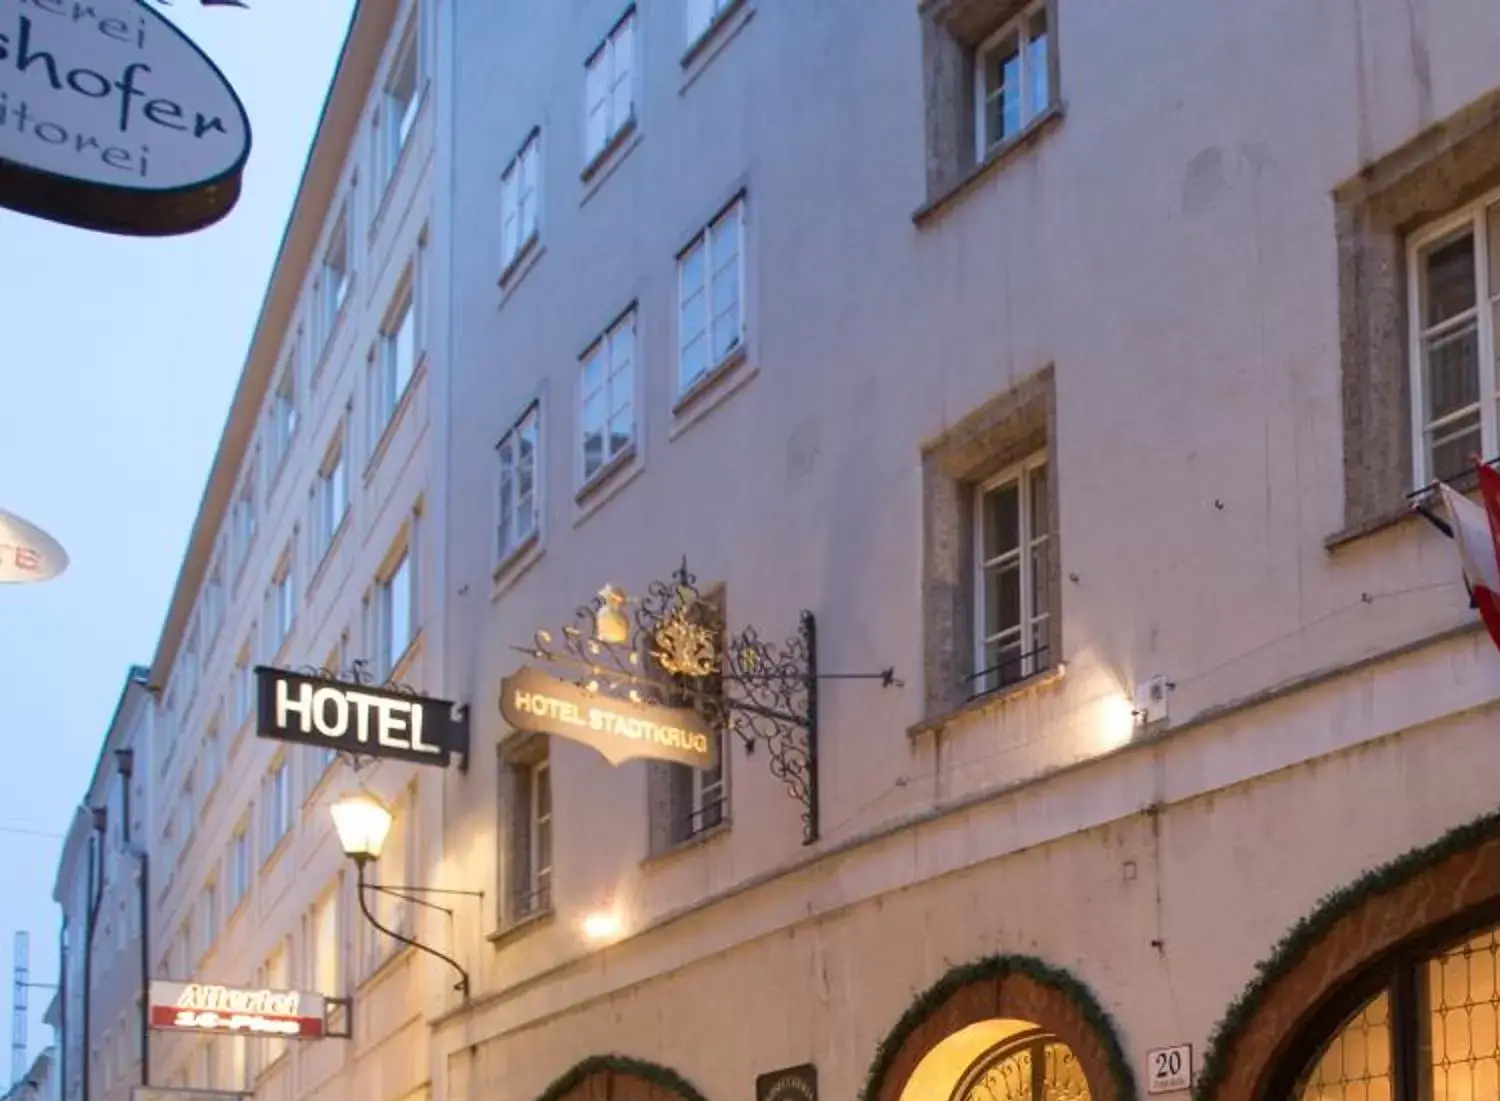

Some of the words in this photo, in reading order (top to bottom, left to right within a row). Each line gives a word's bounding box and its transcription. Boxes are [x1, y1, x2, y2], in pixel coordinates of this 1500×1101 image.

[275, 679, 440, 754] HOTEL
[514, 689, 587, 727] HOTEL
[1155, 1051, 1182, 1078] 20
